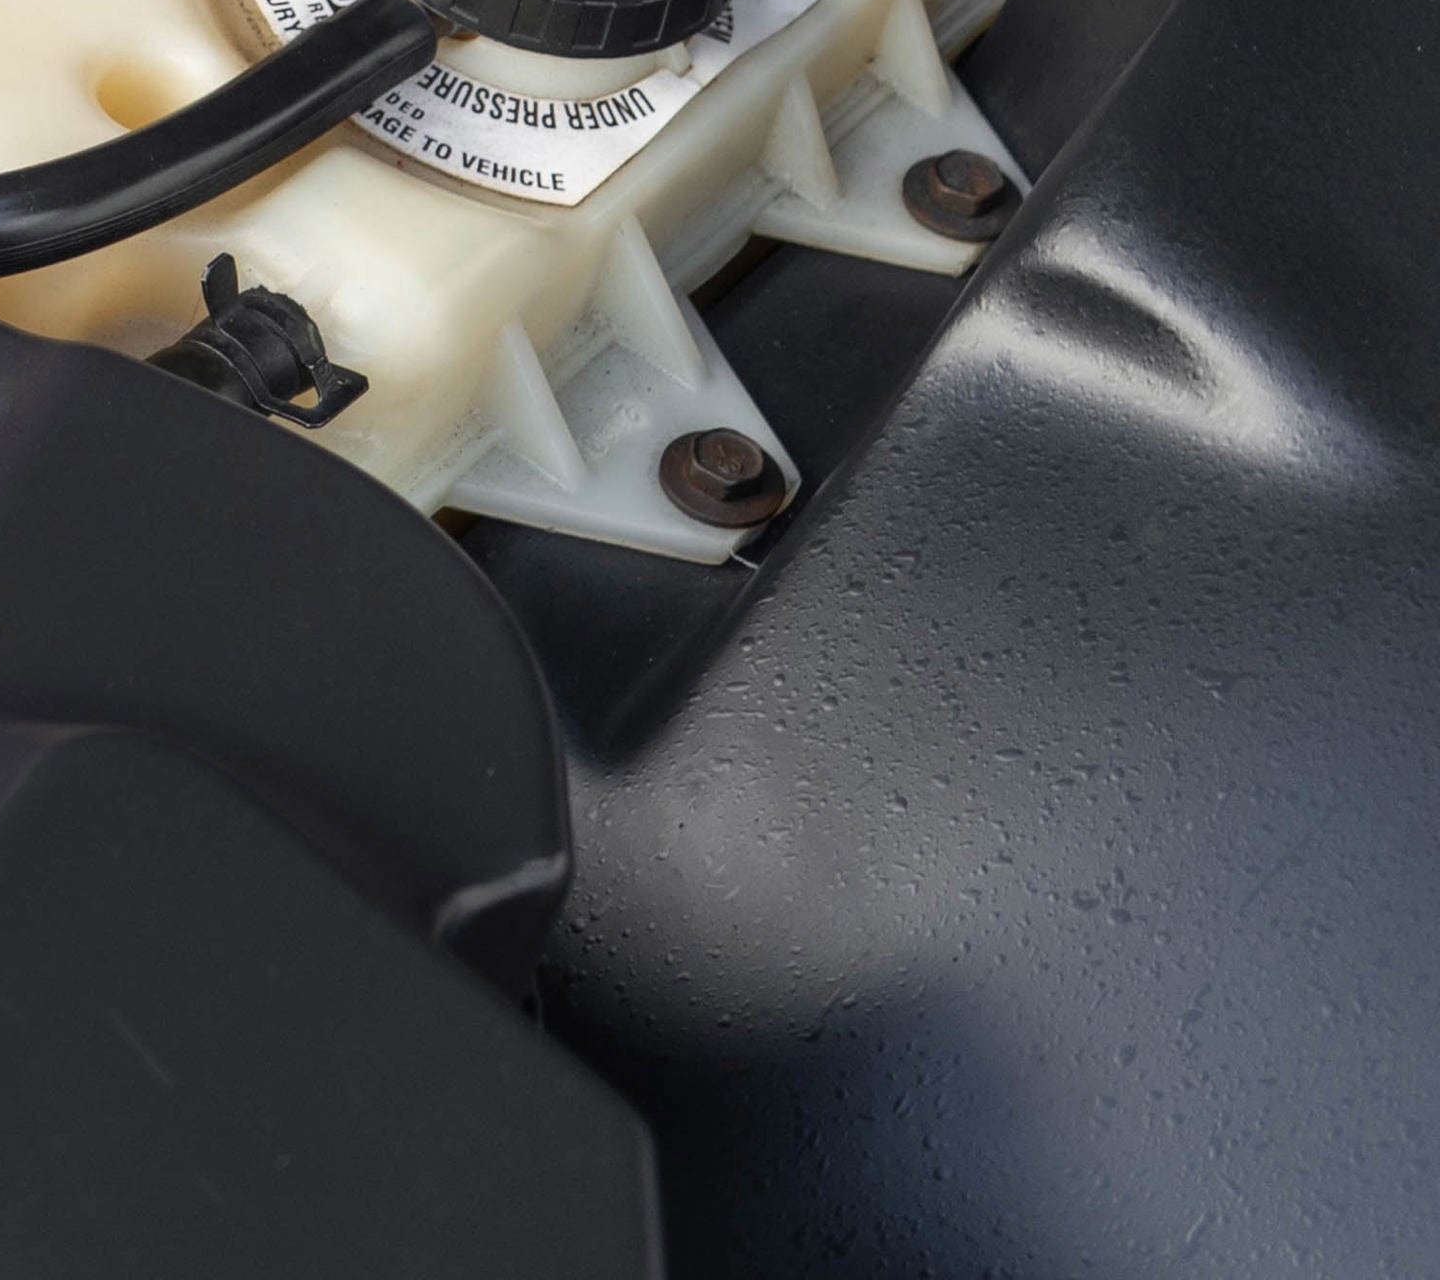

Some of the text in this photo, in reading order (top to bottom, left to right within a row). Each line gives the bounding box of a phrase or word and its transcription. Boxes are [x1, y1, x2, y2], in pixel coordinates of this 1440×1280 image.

[307, 2, 331, 22] RE
[385, 92, 425, 121] DED
[417, 64, 656, 131] UNDER PRESSURE
[361, 105, 566, 191] AGE TO VEHICLE
